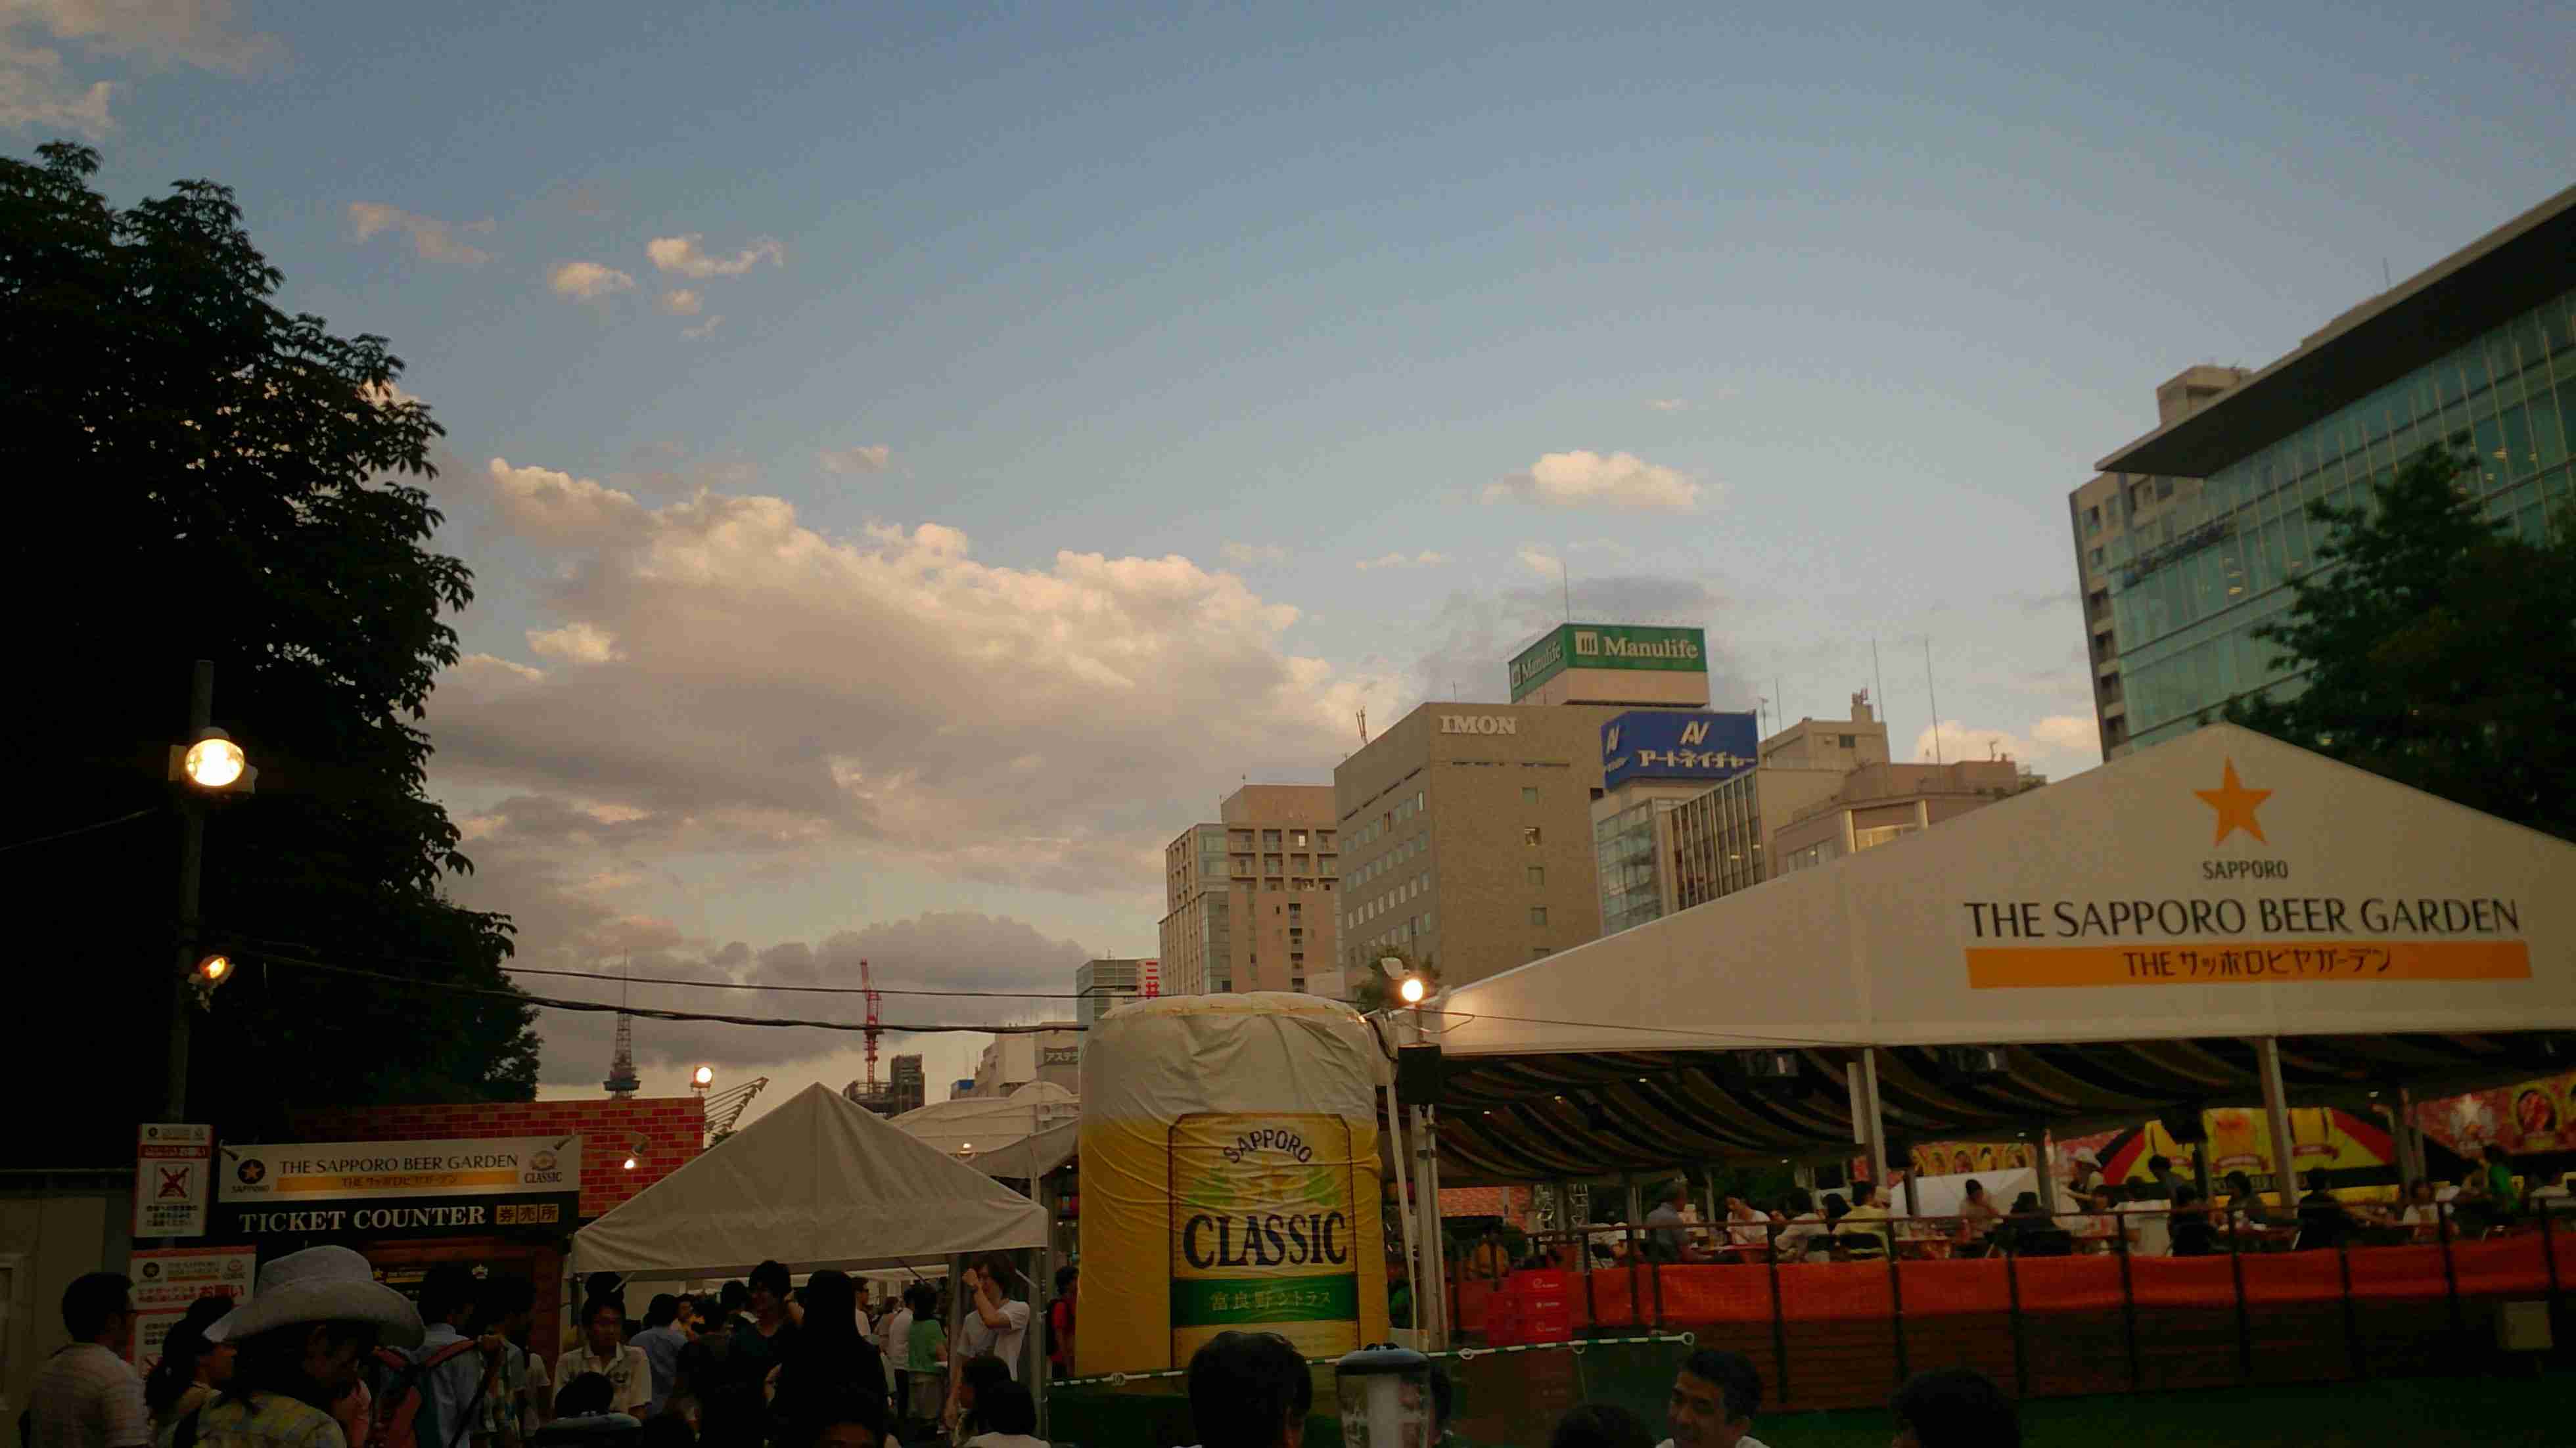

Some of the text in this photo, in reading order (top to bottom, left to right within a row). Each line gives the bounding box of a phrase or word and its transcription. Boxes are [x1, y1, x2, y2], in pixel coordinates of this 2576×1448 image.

[1603, 637, 1699, 658] Manulife
[1523, 641, 1562, 680] Manulife
[1440, 715, 1517, 735] IMON
[1637, 749, 1757, 768] アートネイチャー
[2203, 861, 2288, 880] SAPPORO
[1964, 897, 2521, 938] THE SAPPORO BEER GARDEN
[1224, 1129, 1313, 1164] SAPPORO
[279, 1154, 518, 1175] THE SAPPORO BEER GARDEN
[524, 1171, 563, 1183] CLASSIC
[231, 1185, 270, 1193] SAPPORO
[238, 1210, 346, 1234] TICKET
[352, 1205, 488, 1231] COUNTER
[1184, 1211, 1346, 1268] CLASSIC
